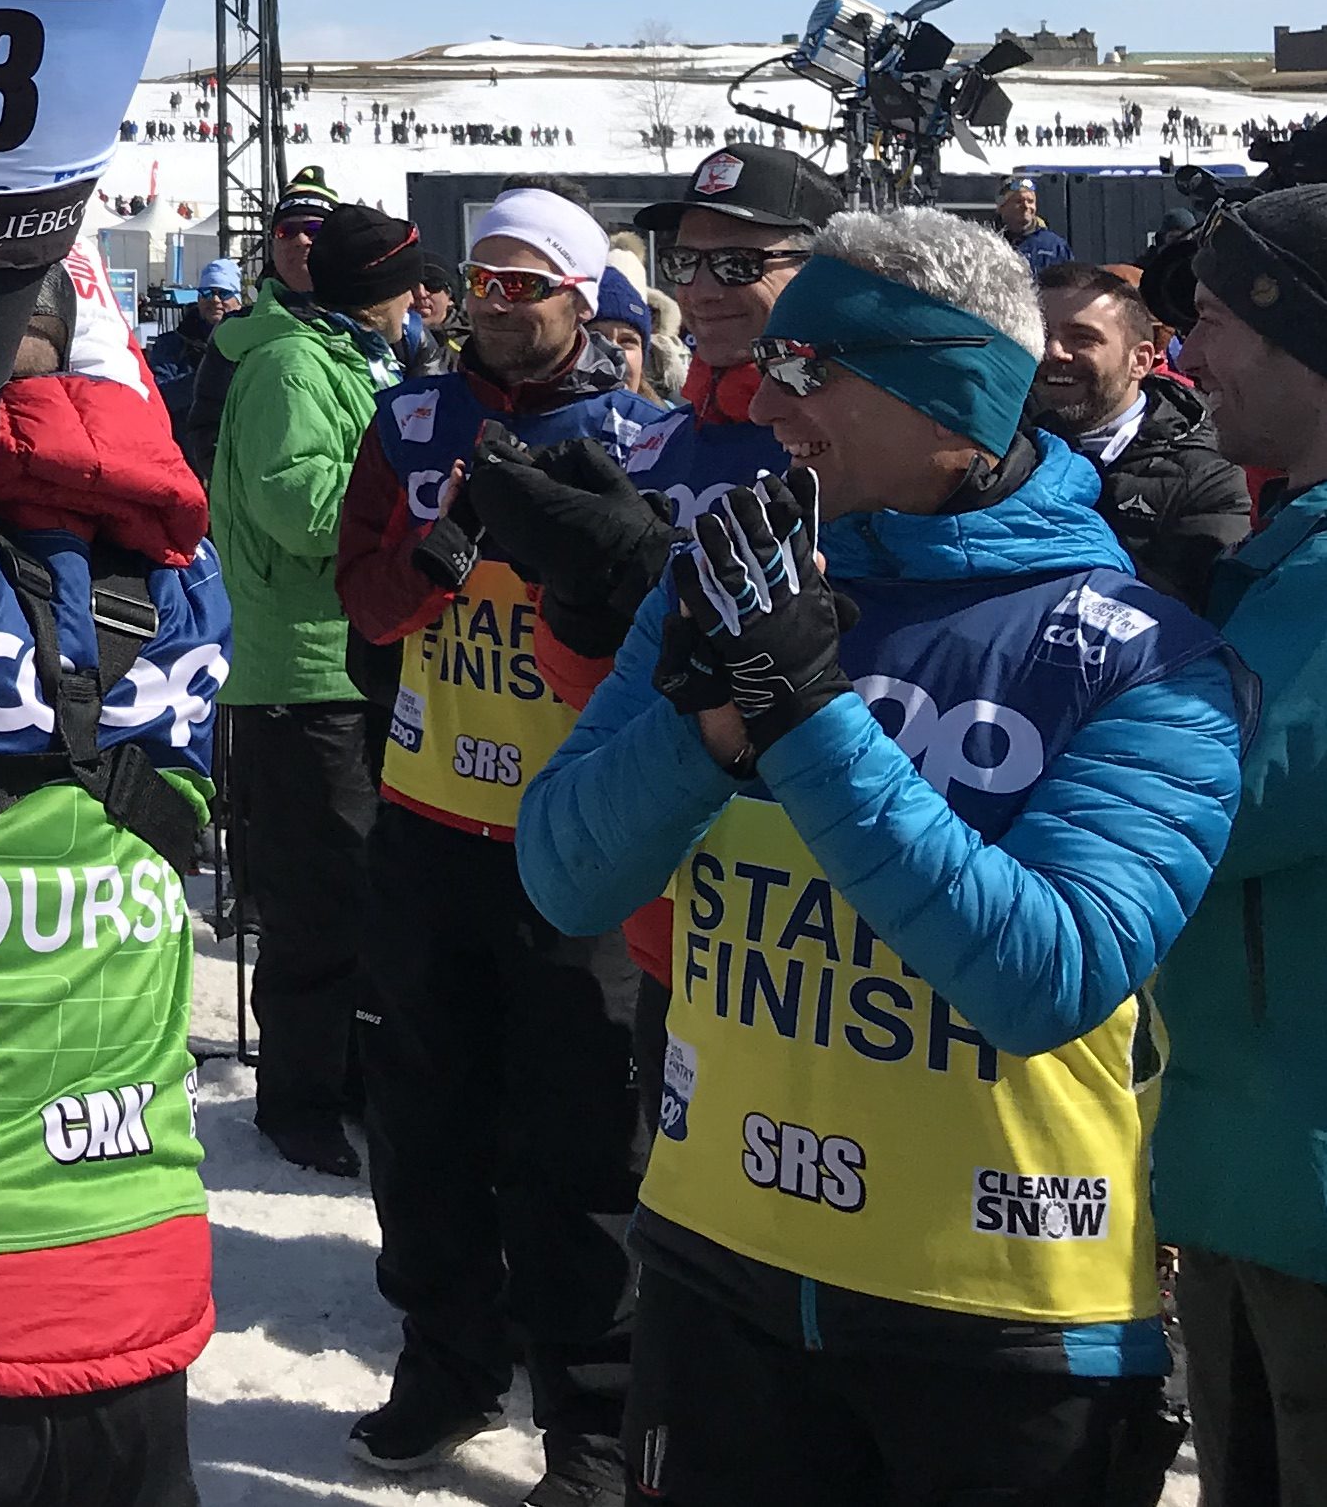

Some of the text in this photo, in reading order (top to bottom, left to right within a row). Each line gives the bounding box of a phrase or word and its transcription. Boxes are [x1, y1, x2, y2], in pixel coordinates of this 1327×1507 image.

[420, 633, 566, 704] FINIS
[453, 734, 522, 787] SRS
[687, 931, 1000, 1083] FINISH
[40, 1081, 157, 1166] CAN
[742, 1110, 867, 1213] SRS
[978, 1170, 1107, 1200] CLEAN AS
[976, 1195, 1107, 1239] SNOW
